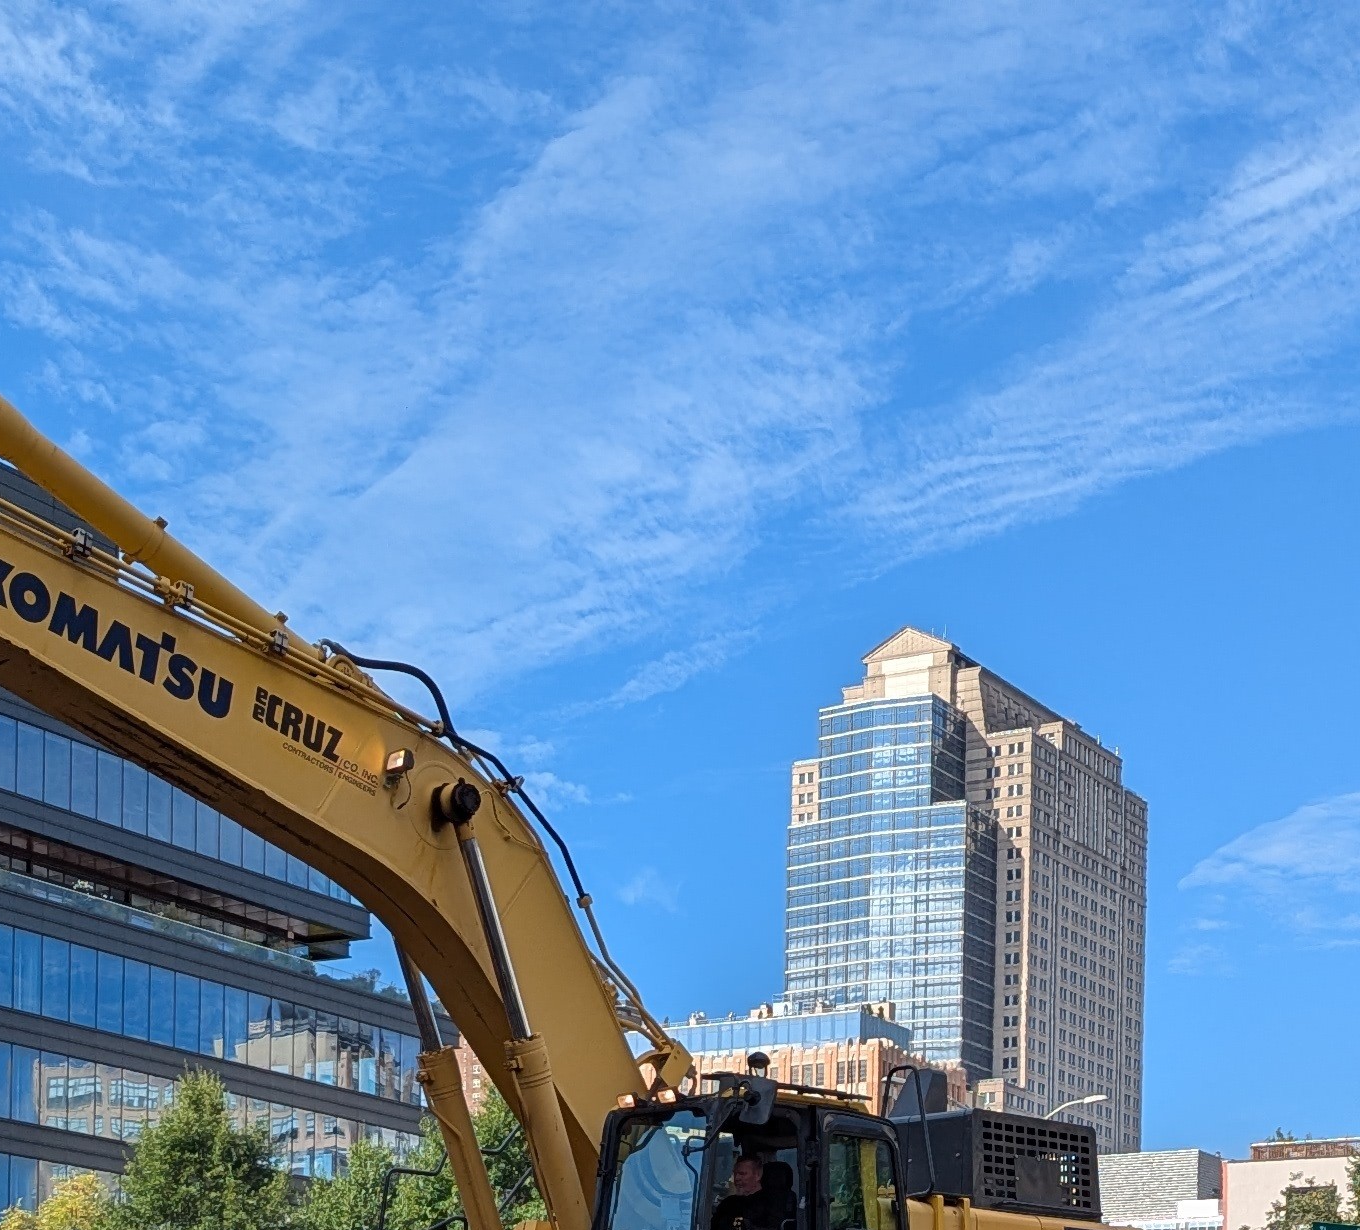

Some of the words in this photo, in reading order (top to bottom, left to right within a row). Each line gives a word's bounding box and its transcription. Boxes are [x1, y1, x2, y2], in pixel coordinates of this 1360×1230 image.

[265, 694, 343, 764] CRUZ
[282, 742, 335, 774] CONTRACTORS
[338, 772, 376, 797] ENGINEERS
[343, 760, 360, 775] CO.
[361, 769, 379, 786] INC.
